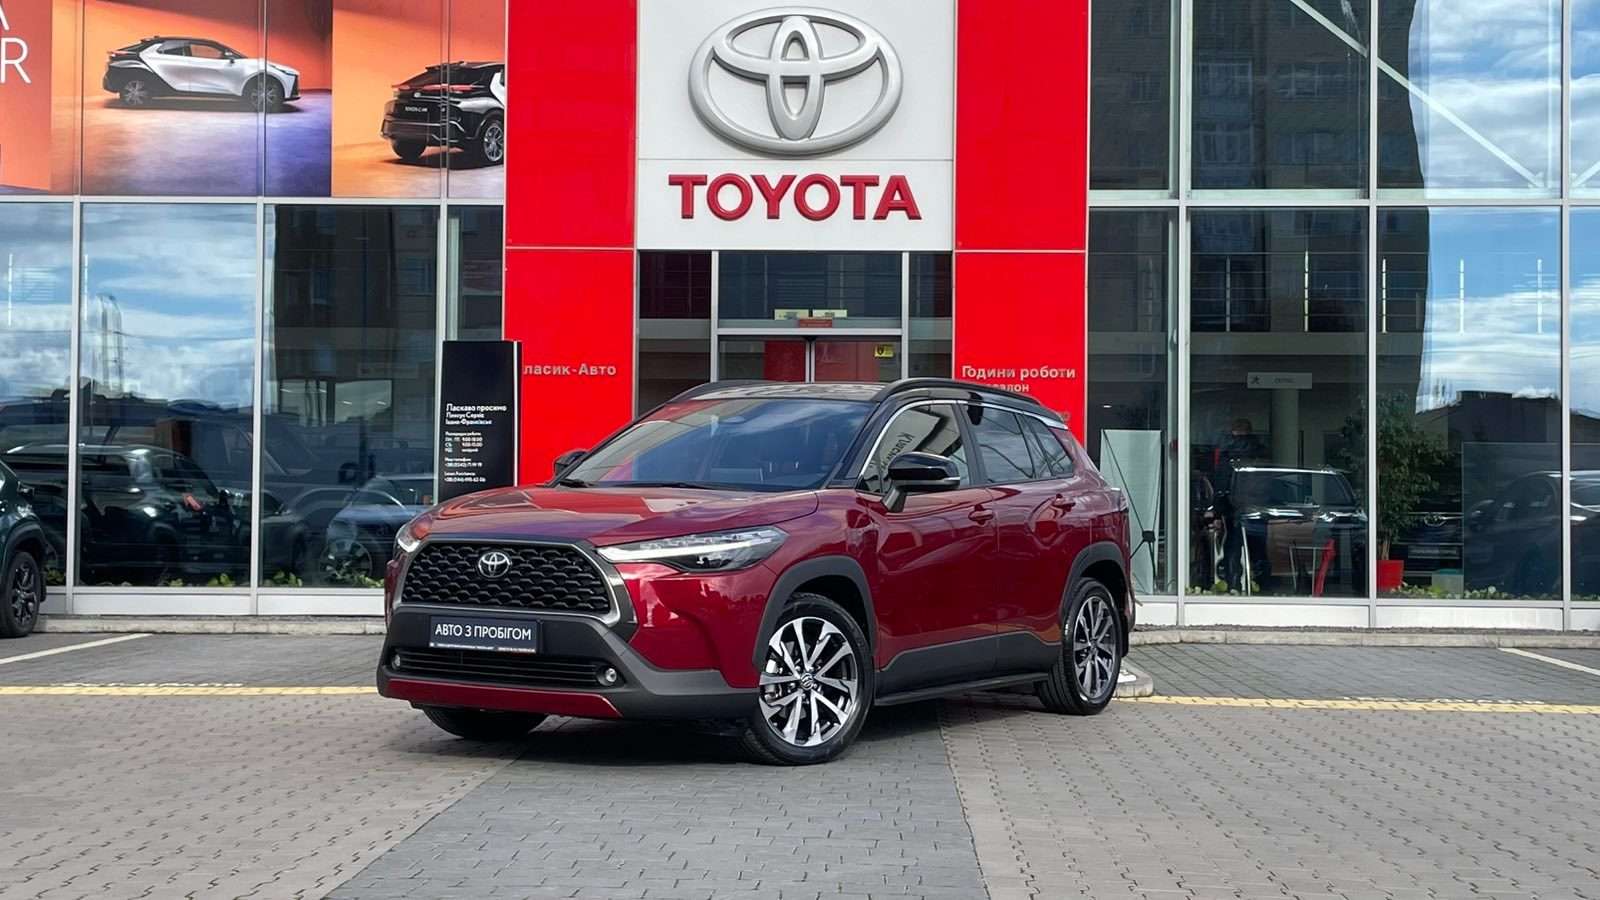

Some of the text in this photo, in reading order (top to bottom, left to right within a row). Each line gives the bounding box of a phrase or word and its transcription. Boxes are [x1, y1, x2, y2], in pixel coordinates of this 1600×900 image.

[668, 173, 922, 222] TOYOTA
[523, 363, 617, 376] ласик-Авто
[961, 365, 1076, 380] Години роботи
[435, 623, 463, 637] АВТО
[473, 625, 532, 641] ПРОБІГОМ
